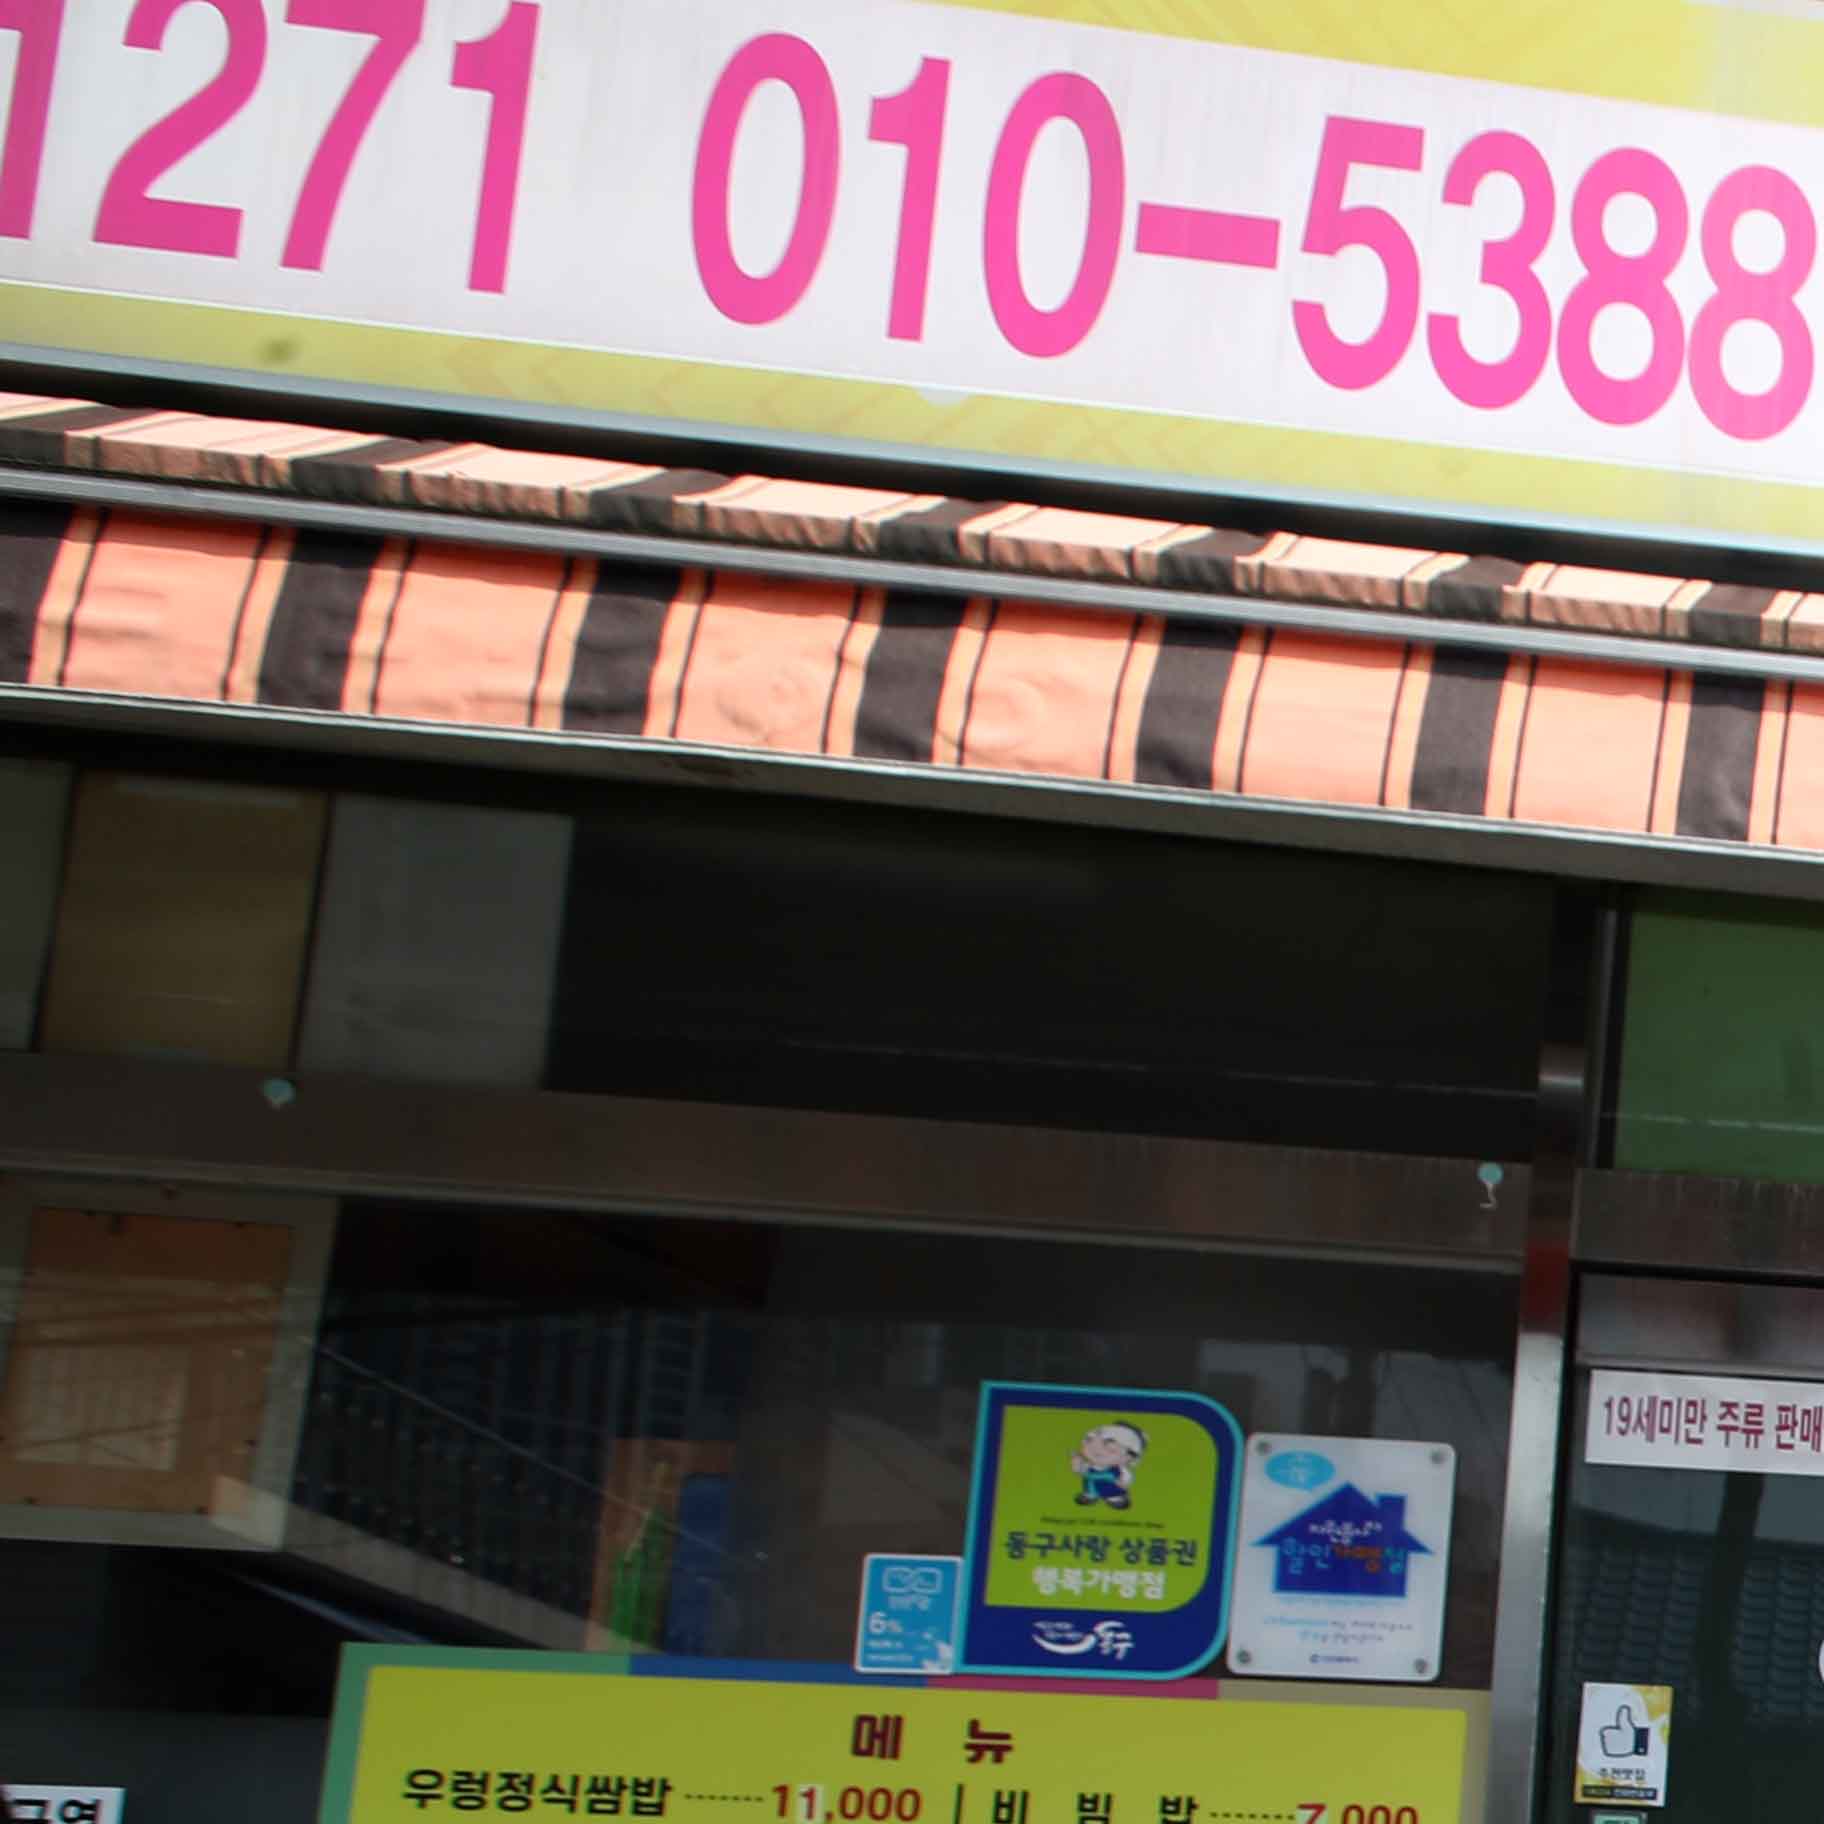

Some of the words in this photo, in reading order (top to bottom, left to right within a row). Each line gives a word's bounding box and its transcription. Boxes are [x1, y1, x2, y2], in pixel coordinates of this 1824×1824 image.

[1604, 1396, 1707, 1445] 19세미만
[1717, 1402, 1765, 1451] 주류
[1006, 1531, 1110, 1563] 동구사랑
[1120, 1538, 1197, 1566] 상품권
[1032, 1566, 1165, 1600] 행복가맹점
[403, 1769, 672, 1817] 우렁정식쌈밥
[772, 1785, 922, 1823] 11,000
